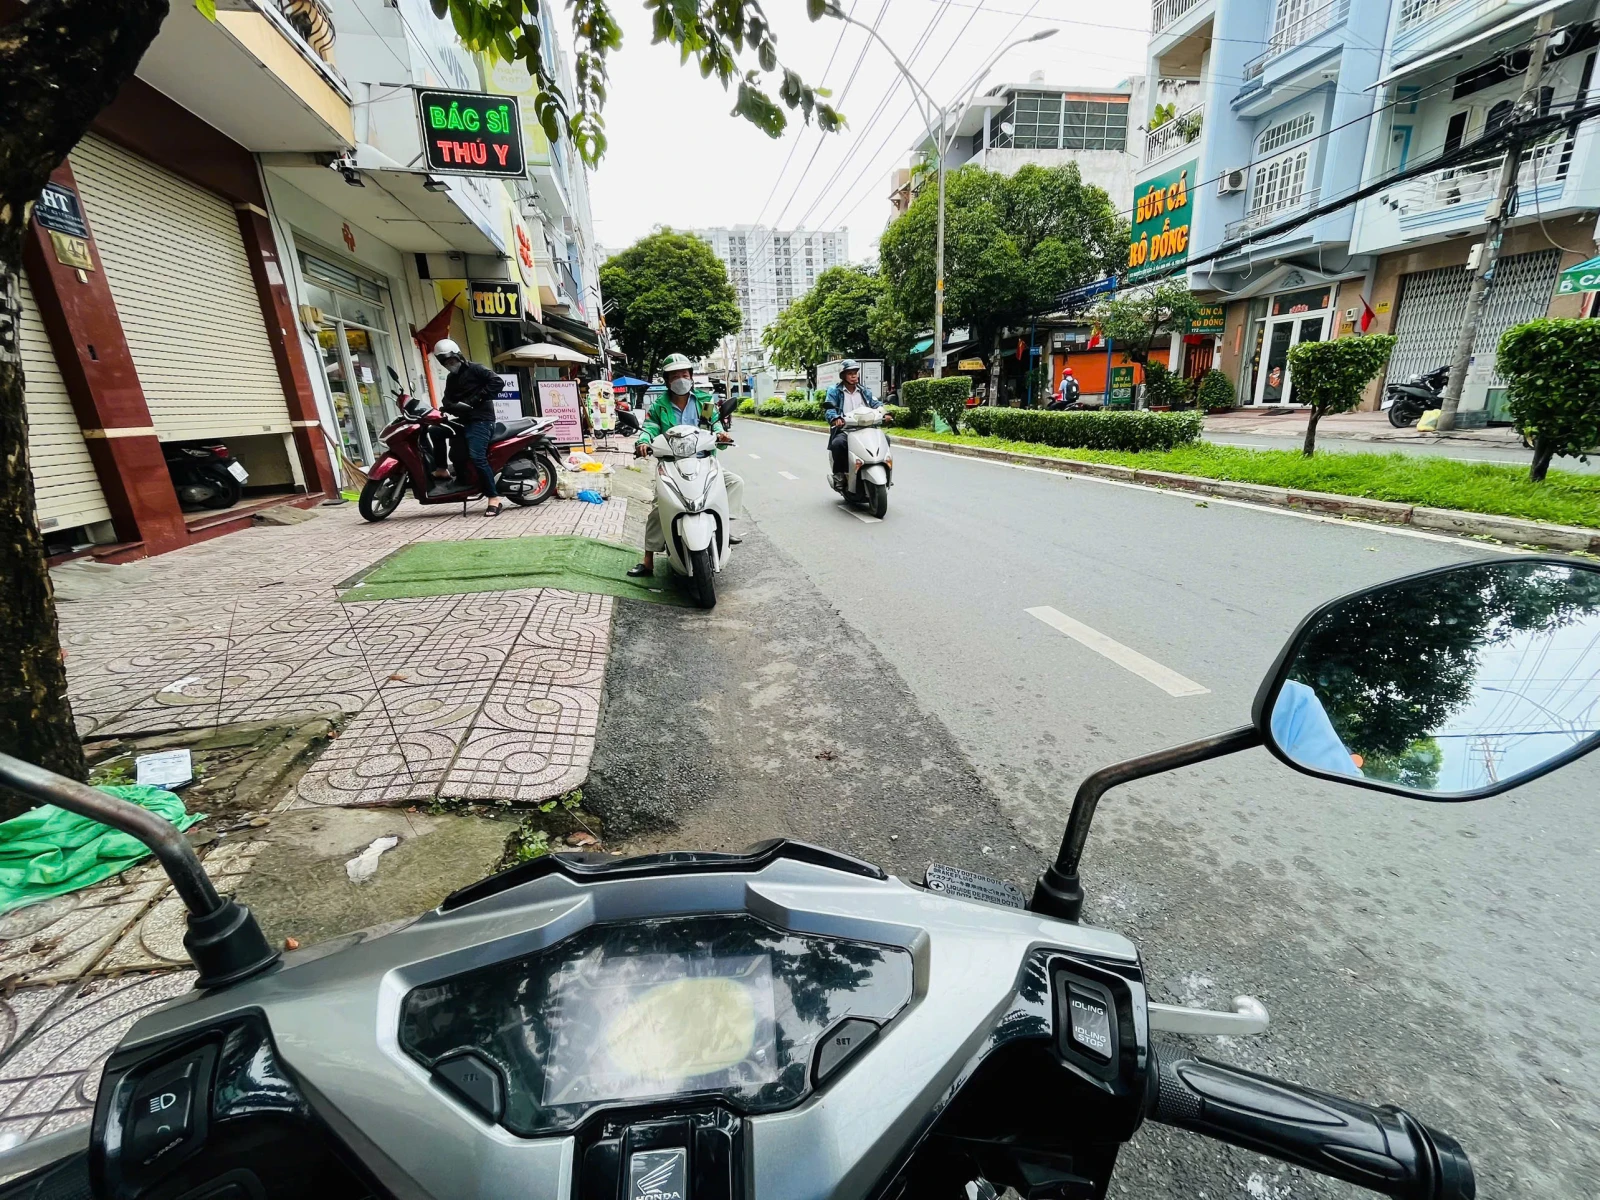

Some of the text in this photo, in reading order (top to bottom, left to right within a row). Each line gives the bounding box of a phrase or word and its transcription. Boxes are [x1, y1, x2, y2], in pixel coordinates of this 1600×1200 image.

[429, 102, 510, 134] BÁC SĨ
[493, 145, 509, 166] Y
[1136, 170, 1187, 223] BÚN CÁ
[67, 239, 88, 261] 47
[1128, 232, 1148, 267] RÔ
[473, 286, 518, 315] THÚ Y
[1198, 306, 1211, 316] ÚN
[933, 862, 945, 870] USE
[945, 866, 961, 874] ONLY
[933, 867, 954, 878] BRAKE
[946, 884, 971, 895] LIQUIDE
[972, 890, 982, 898] DE
[1072, 1000, 1103, 1015] IDLING
[836, 1037, 851, 1046] SET
[1075, 1026, 1106, 1042] IDLING
[1078, 1034, 1103, 1047] STOP
[635, 1191, 681, 1200] HONDA
